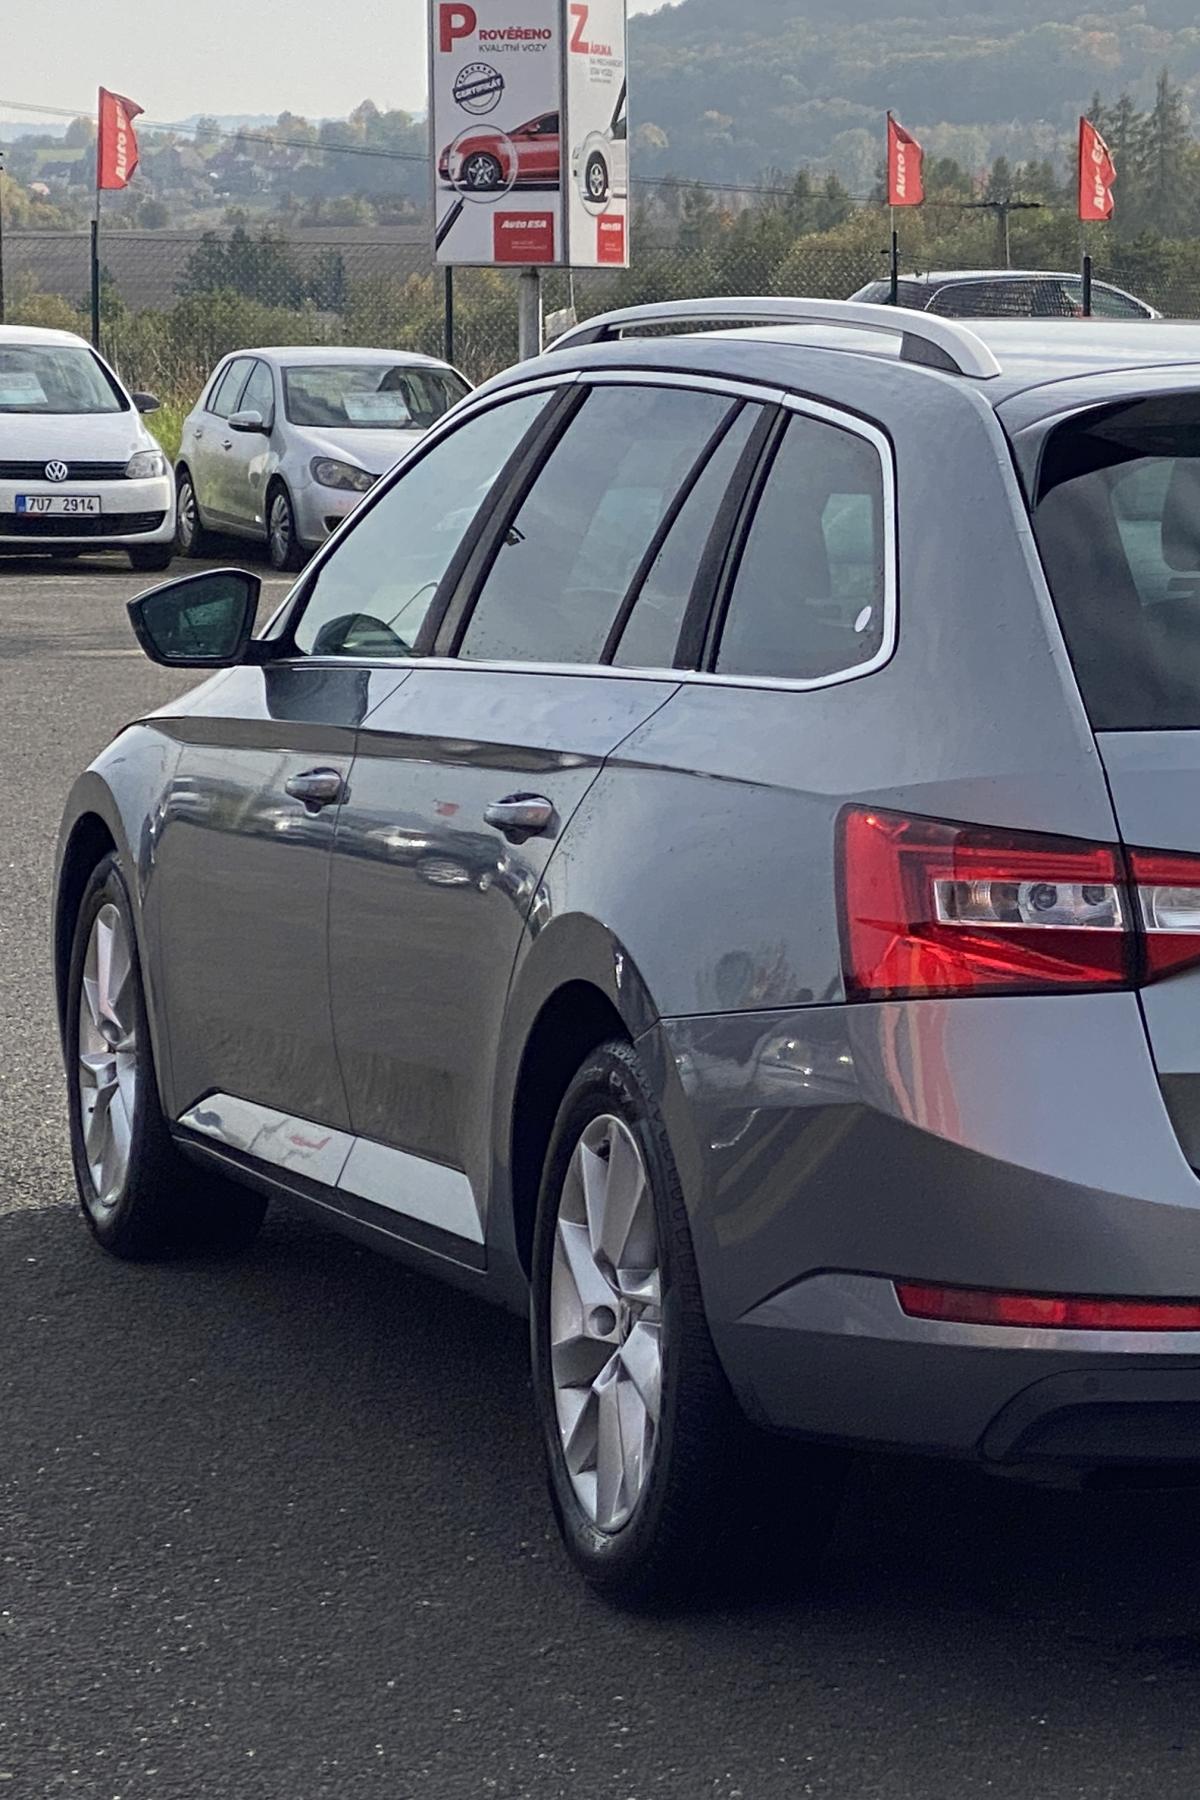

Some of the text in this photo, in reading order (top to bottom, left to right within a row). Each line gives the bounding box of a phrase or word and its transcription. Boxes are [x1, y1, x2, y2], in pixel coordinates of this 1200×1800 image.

[522, 43, 547, 52] VOZY
[501, 220, 547, 229] Auto ESA
[29, 498, 51, 512] 7U7
[63, 498, 94, 512] 2914
